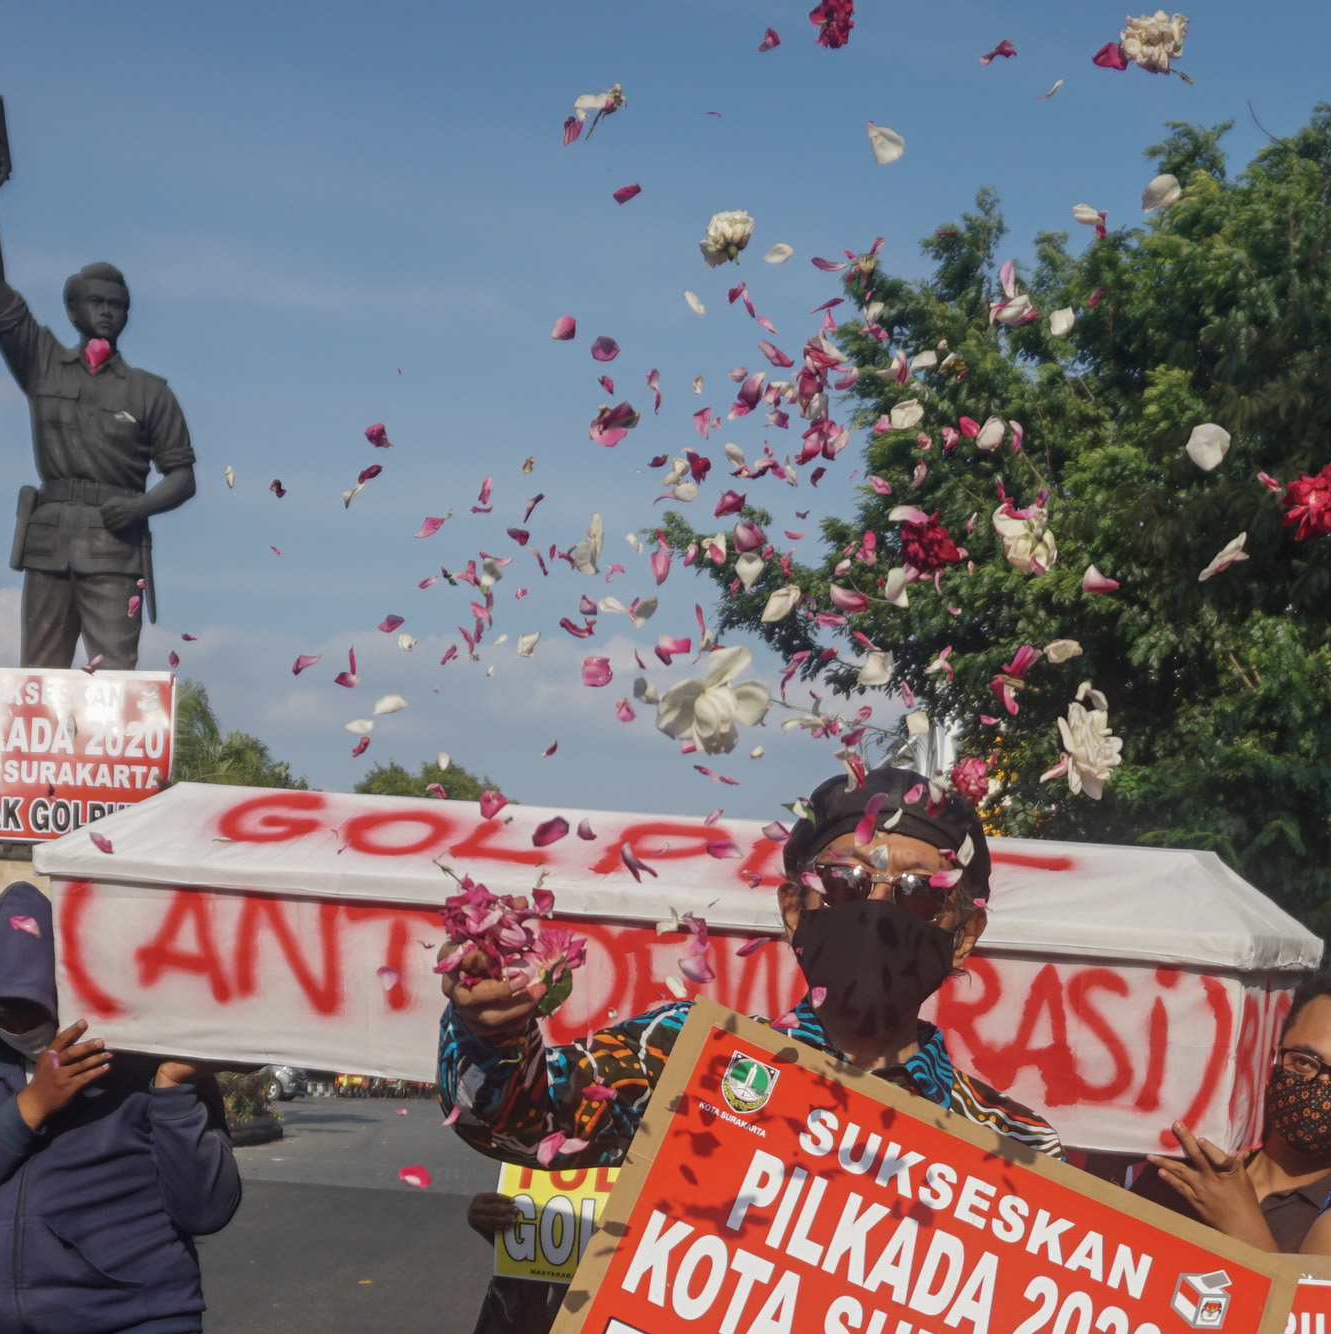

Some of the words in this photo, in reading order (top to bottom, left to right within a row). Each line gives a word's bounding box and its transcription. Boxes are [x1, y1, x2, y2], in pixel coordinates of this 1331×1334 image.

[84, 721, 165, 759] 2020
[3, 760, 161, 790] SURAKARTA
[31, 798, 132, 833] GOLP
[699, 1101, 720, 1116] KOTA
[720, 1111, 766, 1138] SURAKARTA
[799, 1108, 1153, 1300] SUKSESKAN
